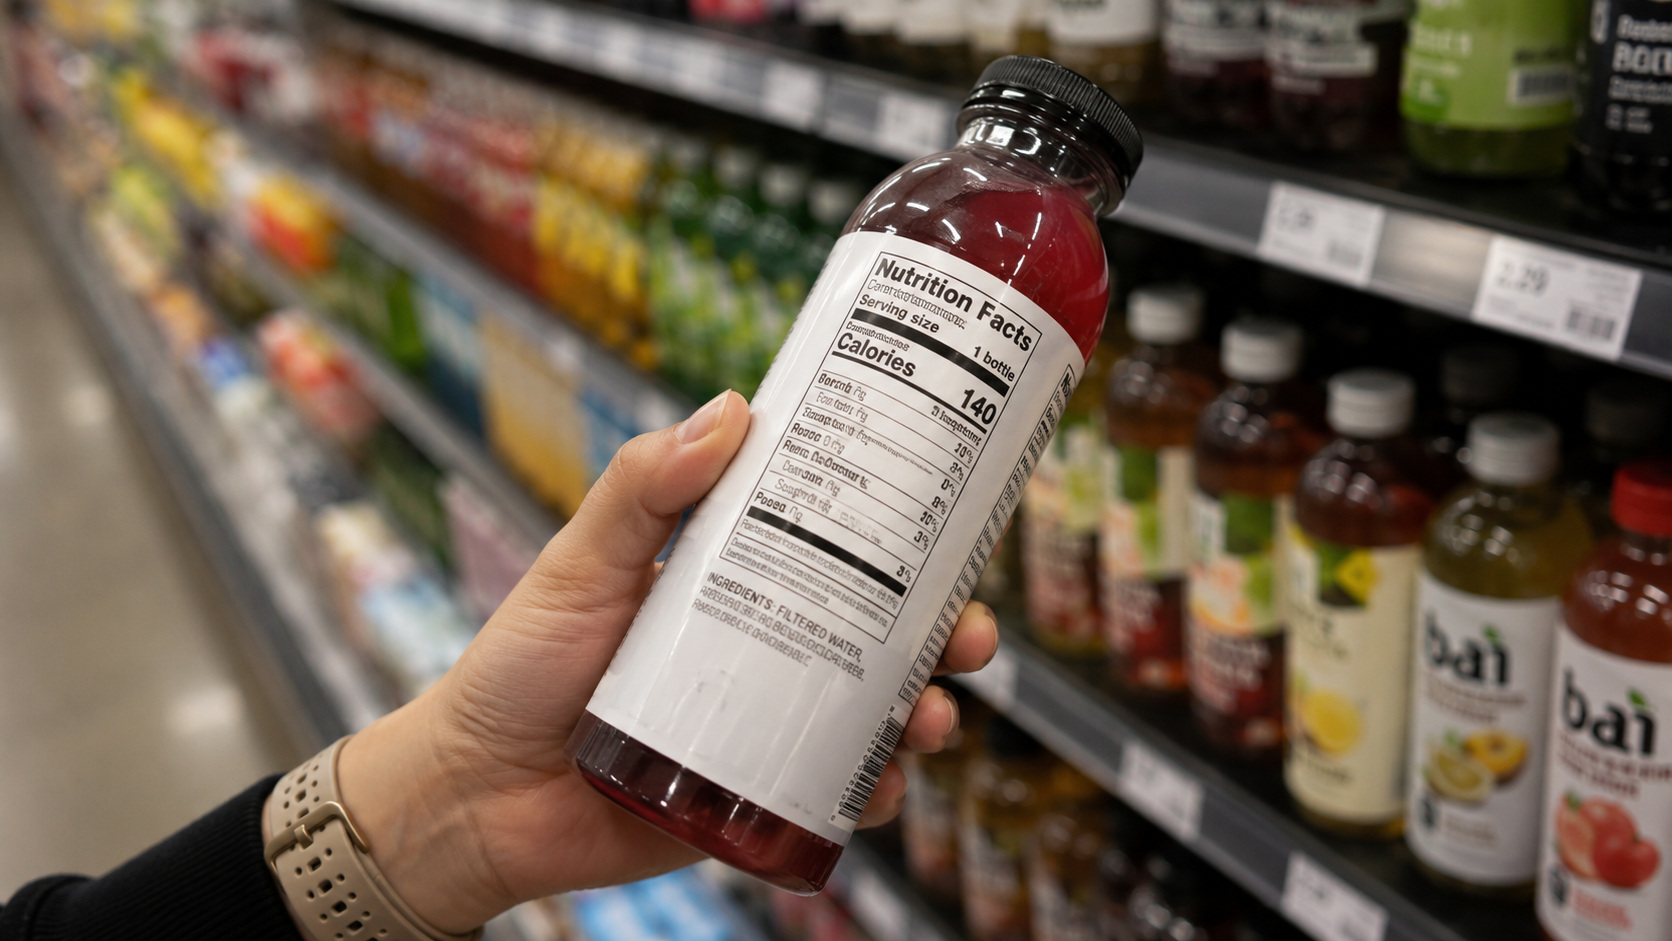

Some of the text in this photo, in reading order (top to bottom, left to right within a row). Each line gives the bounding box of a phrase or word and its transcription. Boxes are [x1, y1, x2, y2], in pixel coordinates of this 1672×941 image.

[859, 294, 908, 321] Serving
[910, 314, 940, 333] size
[874, 258, 973, 313] Nutrition
[976, 300, 1032, 351] Facts
[837, 332, 916, 377] Calories
[974, 346, 1015, 382] 1 bottle
[961, 389, 997, 425] 140
[707, 572, 777, 612] INGREDIENTS:
[776, 605, 828, 640] FILTERED
[828, 632, 863, 663] WATER,
[1425, 609, 1510, 685] bai
[1562, 666, 1656, 756] bai
